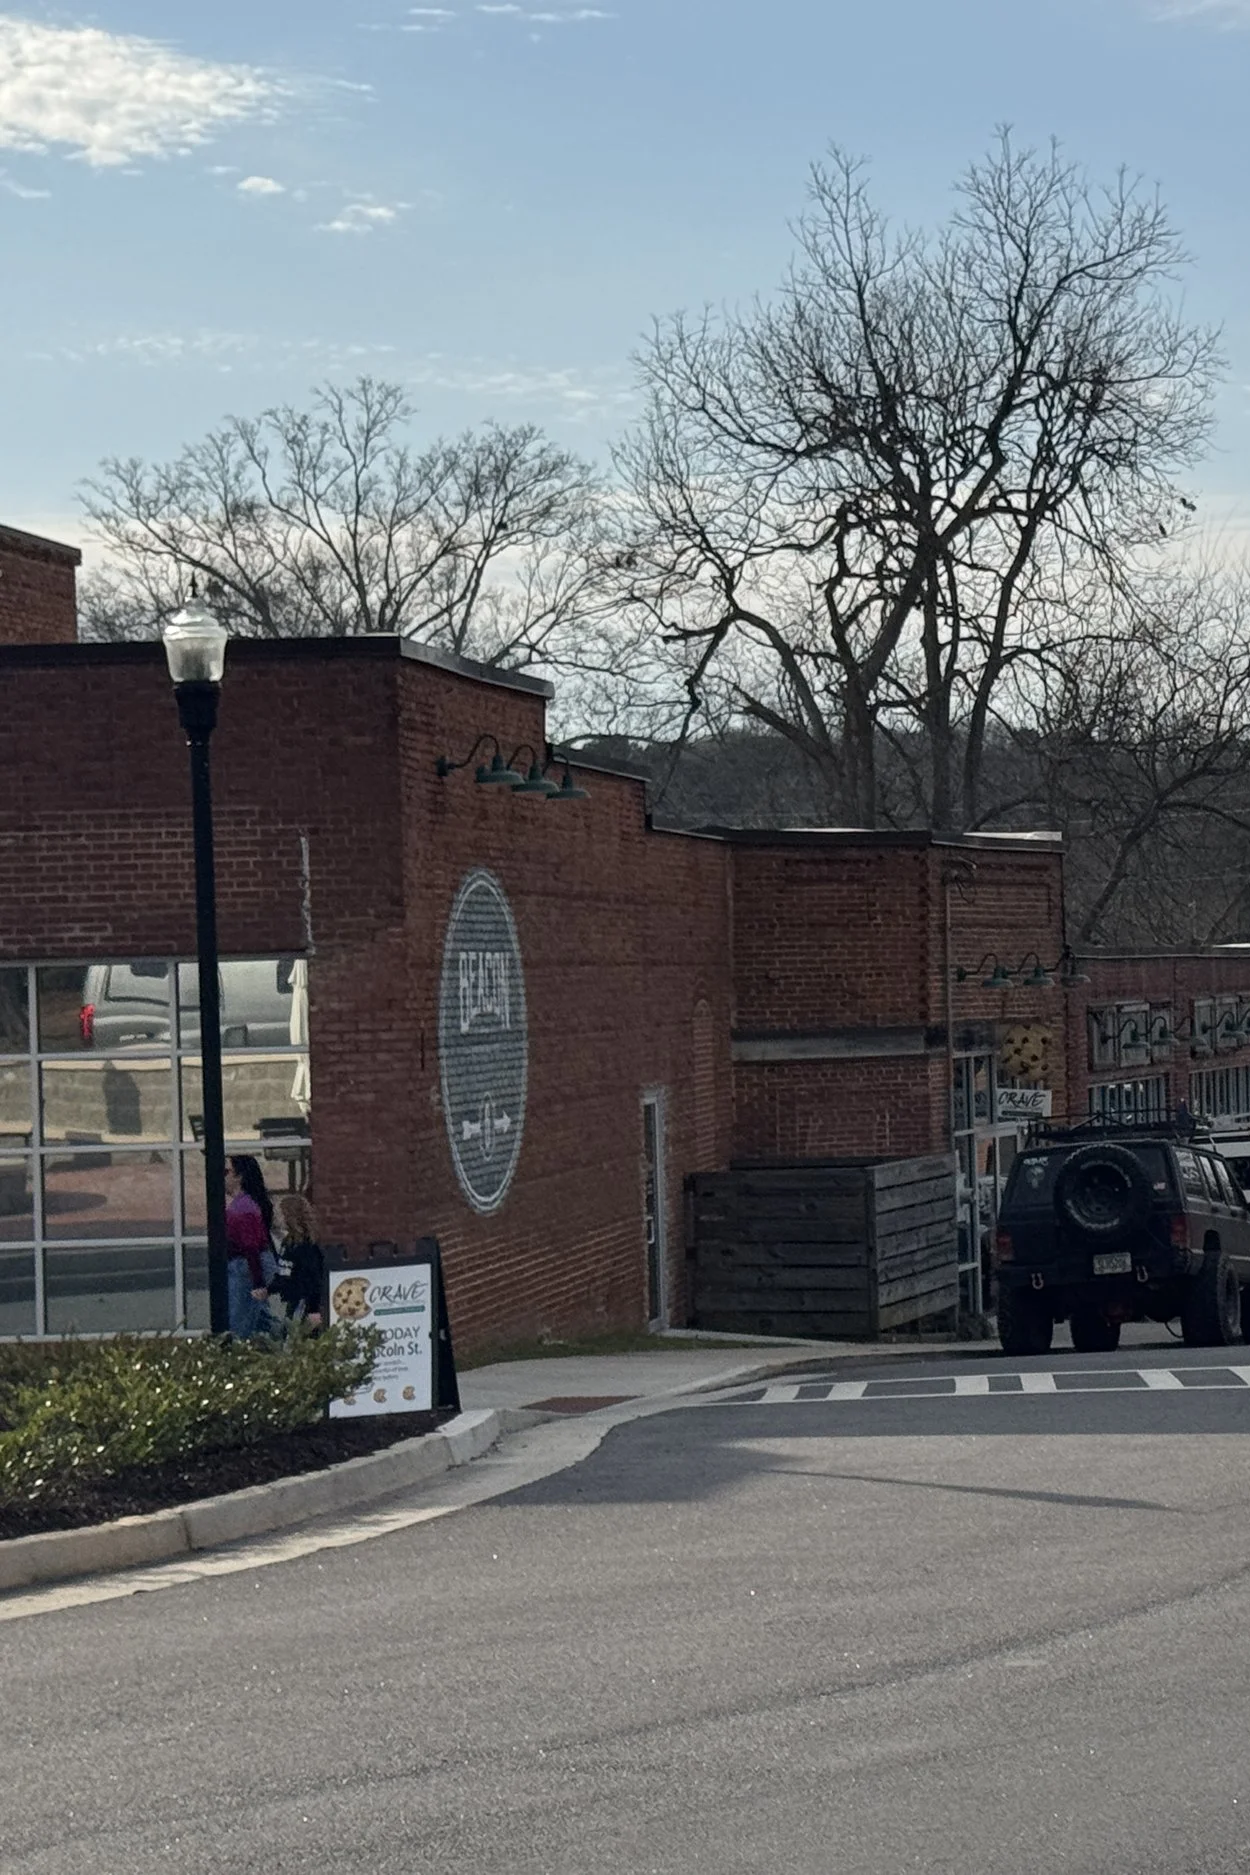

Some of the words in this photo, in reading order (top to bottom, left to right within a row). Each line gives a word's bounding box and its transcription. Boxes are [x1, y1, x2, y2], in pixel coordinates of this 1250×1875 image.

[459, 951, 510, 1033] BEACON
[998, 1091, 1046, 1108] CRAVE
[369, 1280, 428, 1303] CRAVE
[381, 1326, 421, 1340] ODAY
[407, 1341, 422, 1356] St.
